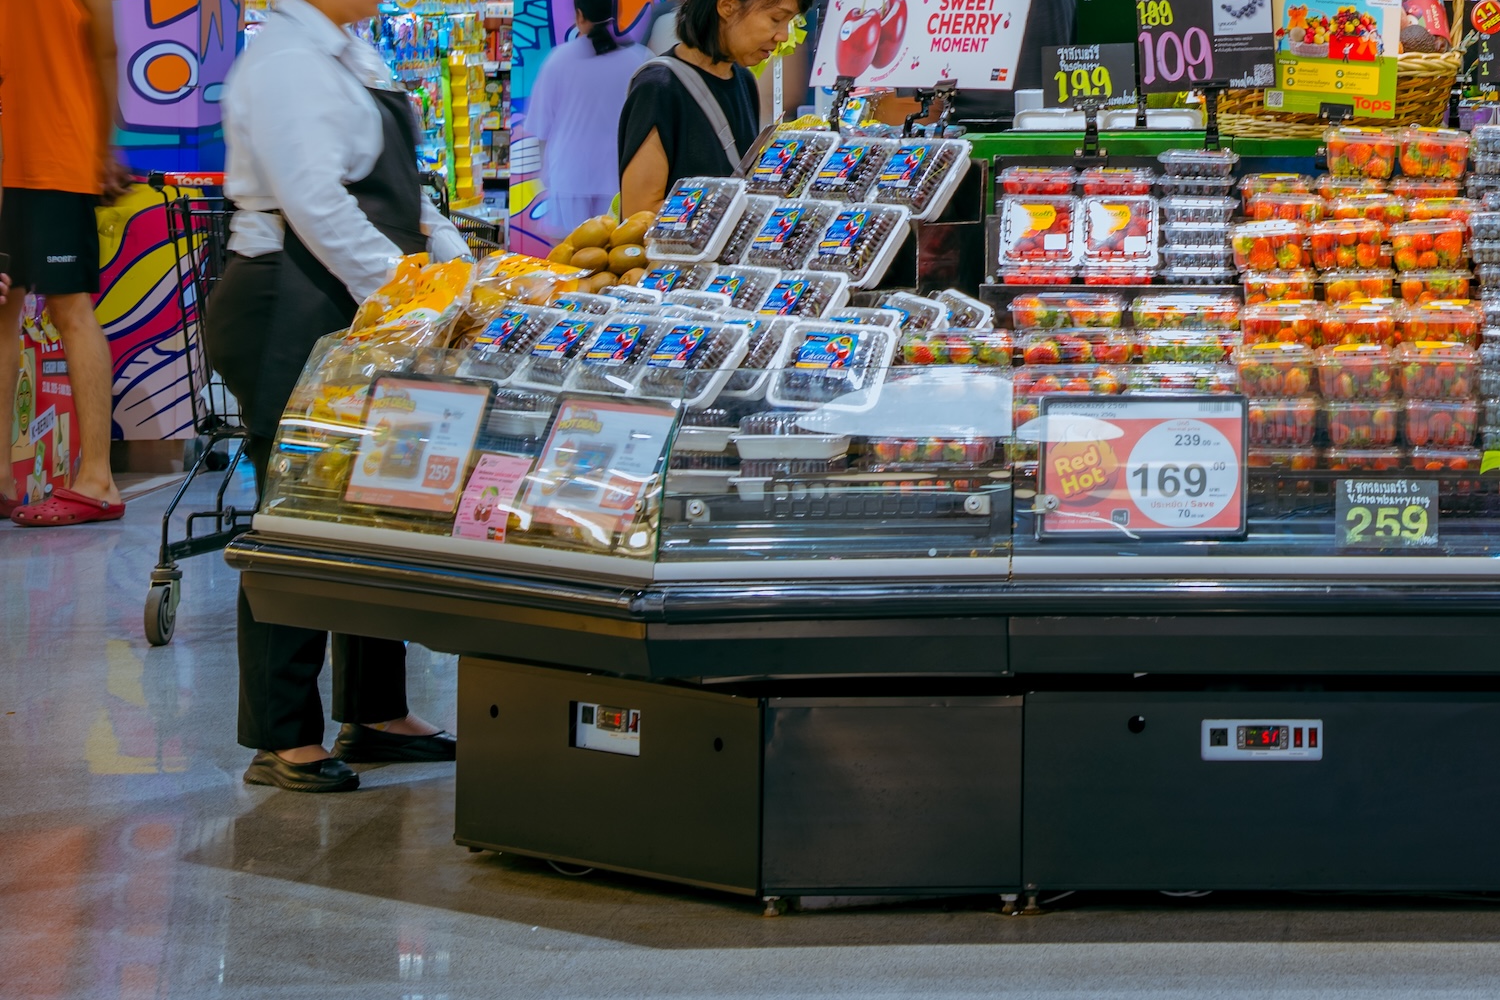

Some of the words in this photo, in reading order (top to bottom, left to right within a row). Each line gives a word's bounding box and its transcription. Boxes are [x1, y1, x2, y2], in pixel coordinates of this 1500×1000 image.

[927, 13, 1003, 34] CHERRY
[930, 38, 989, 53] MOMENT
[1138, 26, 1214, 86] 109
[1054, 66, 1112, 104] 199
[1353, 96, 1391, 113] Tops
[429, 465, 450, 481] 259
[1054, 445, 1099, 477] Red
[1060, 466, 1105, 497] Hot
[1132, 464, 1207, 498] 169
[1190, 500, 1215, 508] Save
[1346, 505, 1428, 543] 259
